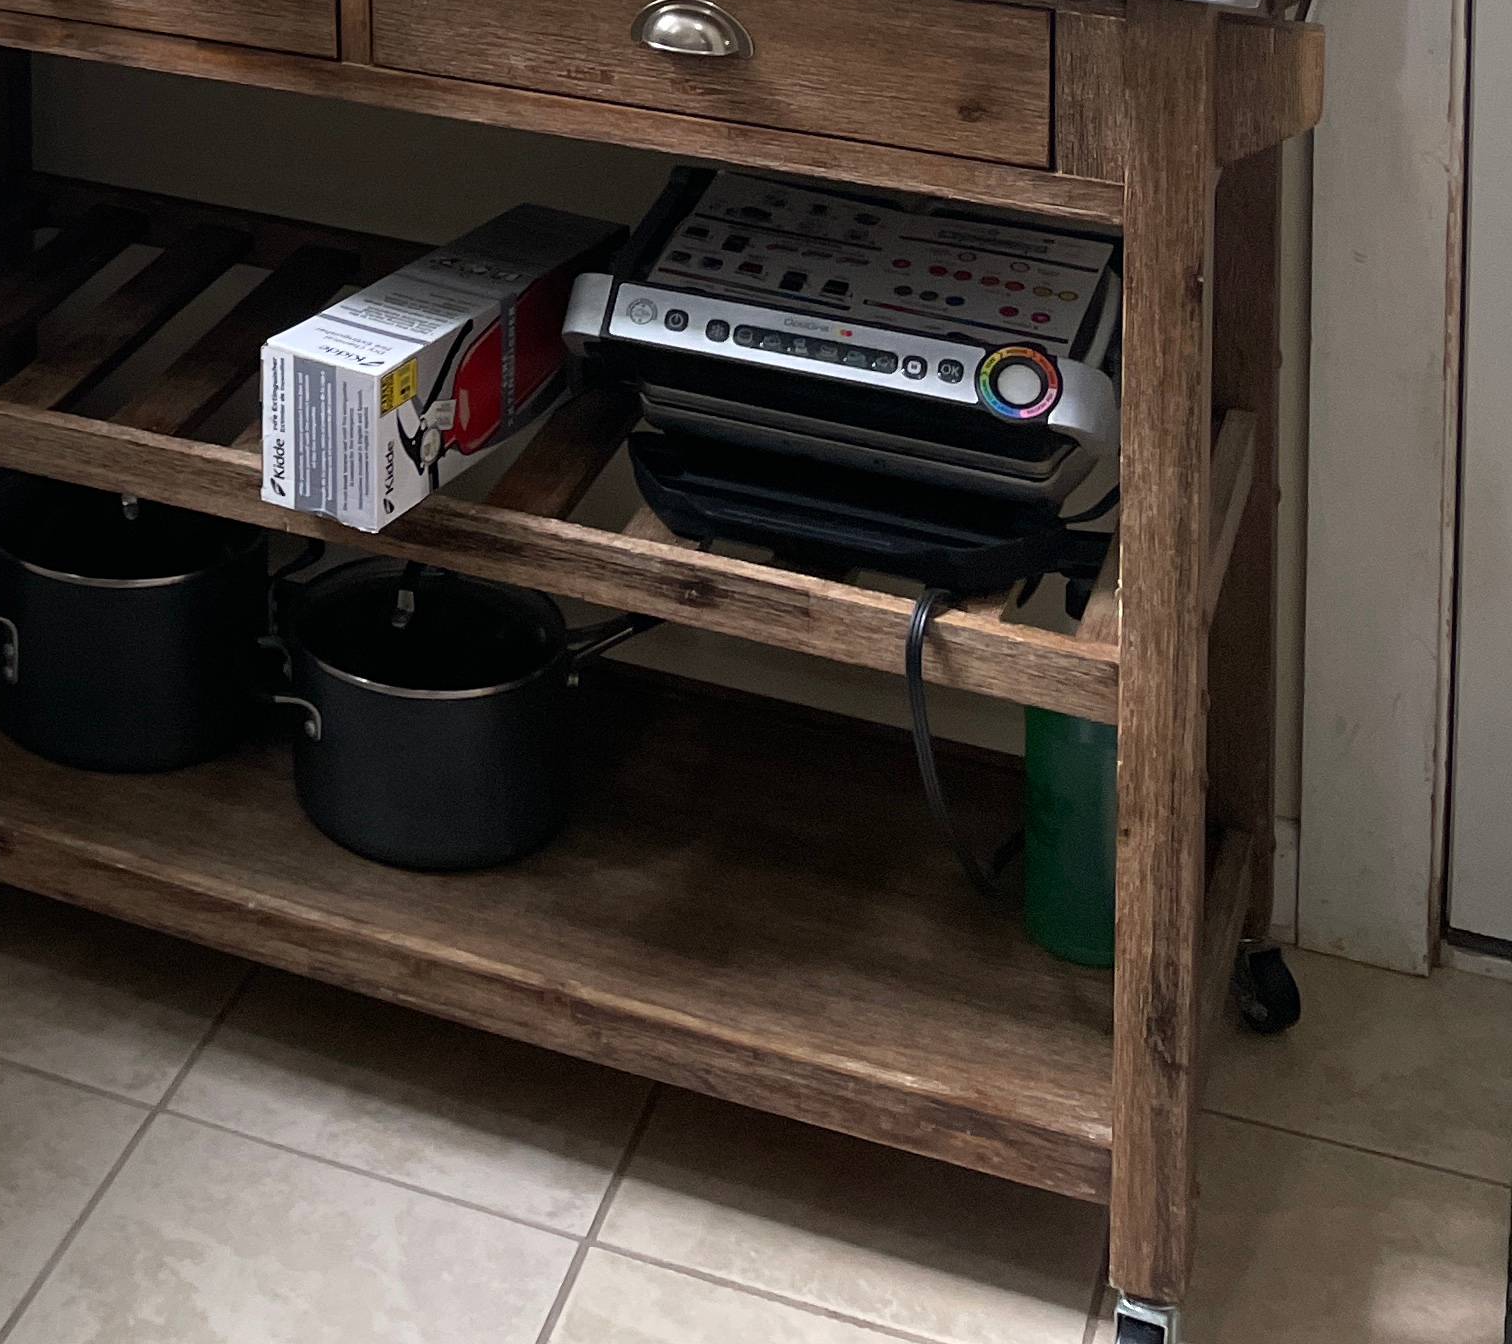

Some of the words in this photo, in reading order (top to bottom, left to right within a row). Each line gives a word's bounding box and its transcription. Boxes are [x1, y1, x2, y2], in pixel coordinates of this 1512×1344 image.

[318, 346, 366, 363] Kidde
[940, 364, 960, 378] OK
[272, 438, 285, 480] Kidde
[384, 440, 395, 495] Kidde
